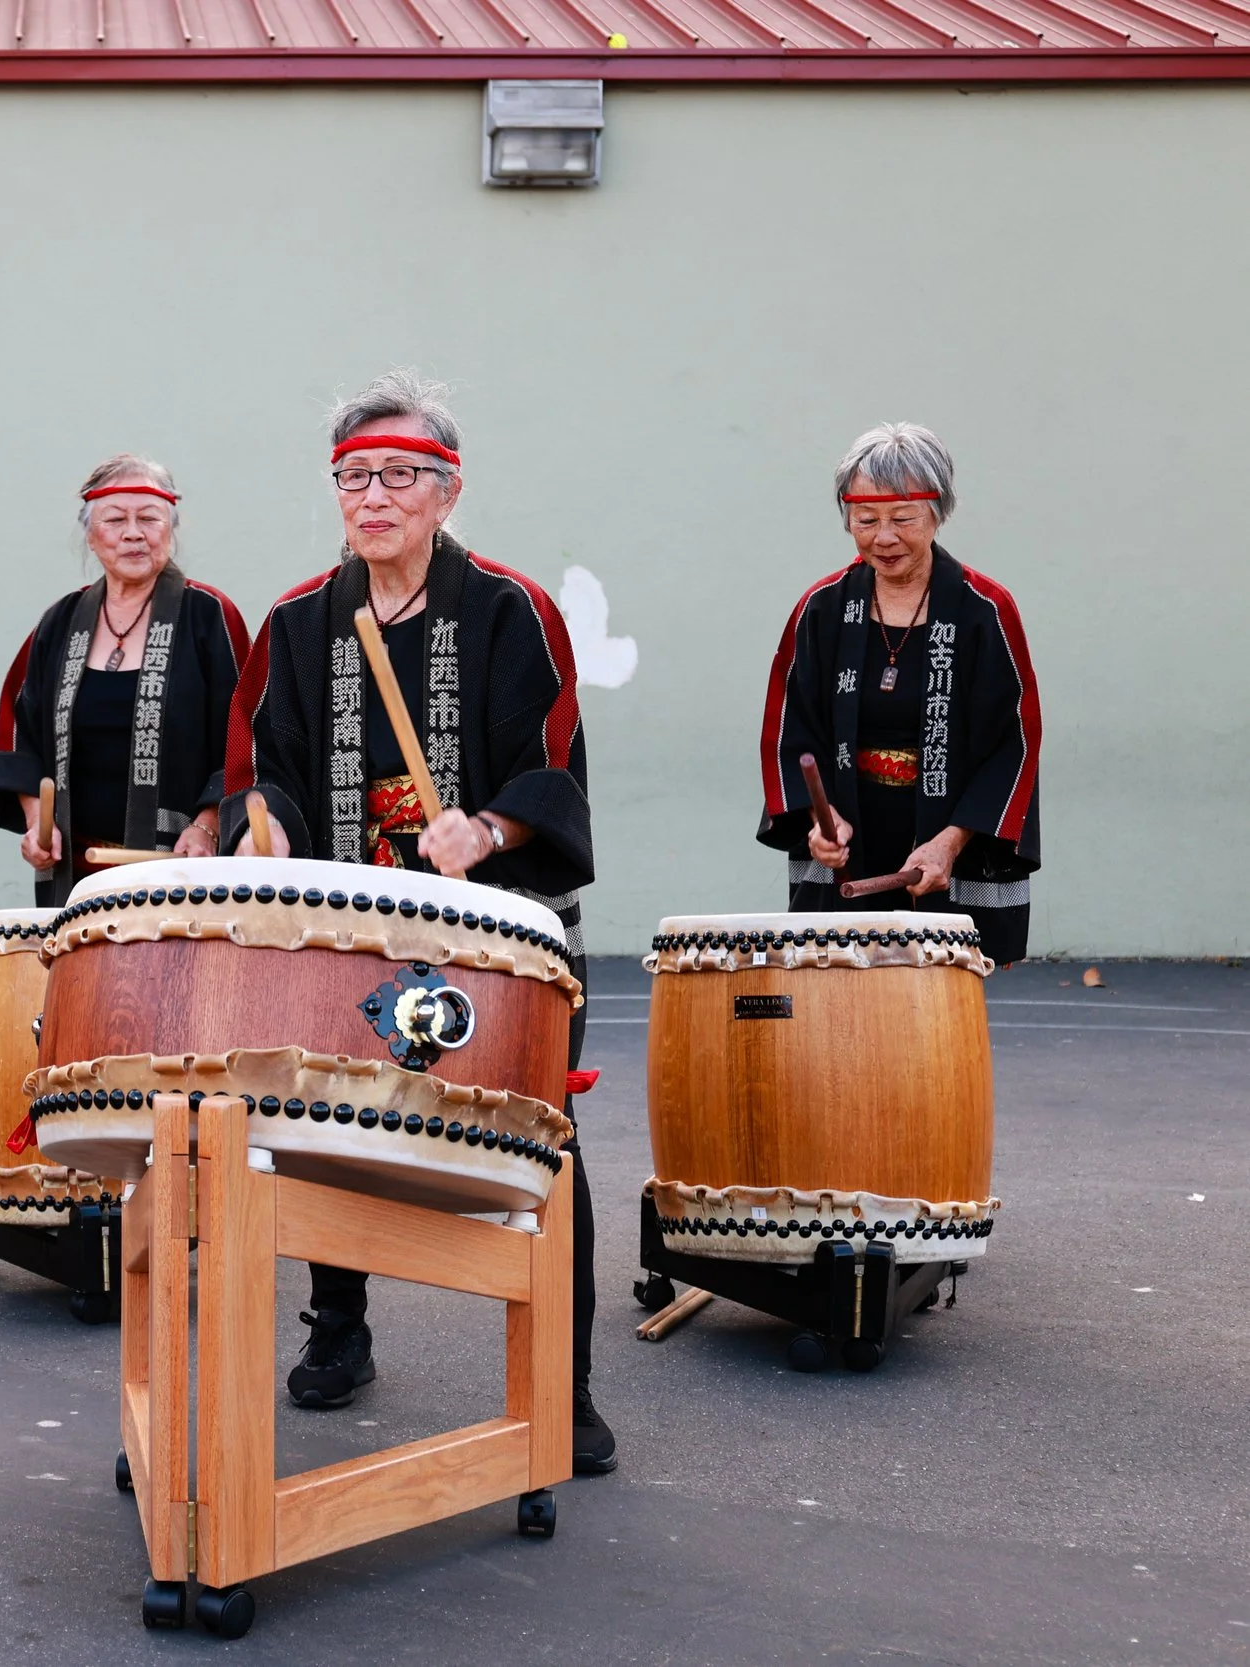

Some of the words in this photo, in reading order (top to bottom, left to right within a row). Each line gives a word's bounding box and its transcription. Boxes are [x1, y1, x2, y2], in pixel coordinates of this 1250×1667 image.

[133, 621, 173, 786] 加西市消防団
[922, 620, 957, 797] 加古川市消防団
